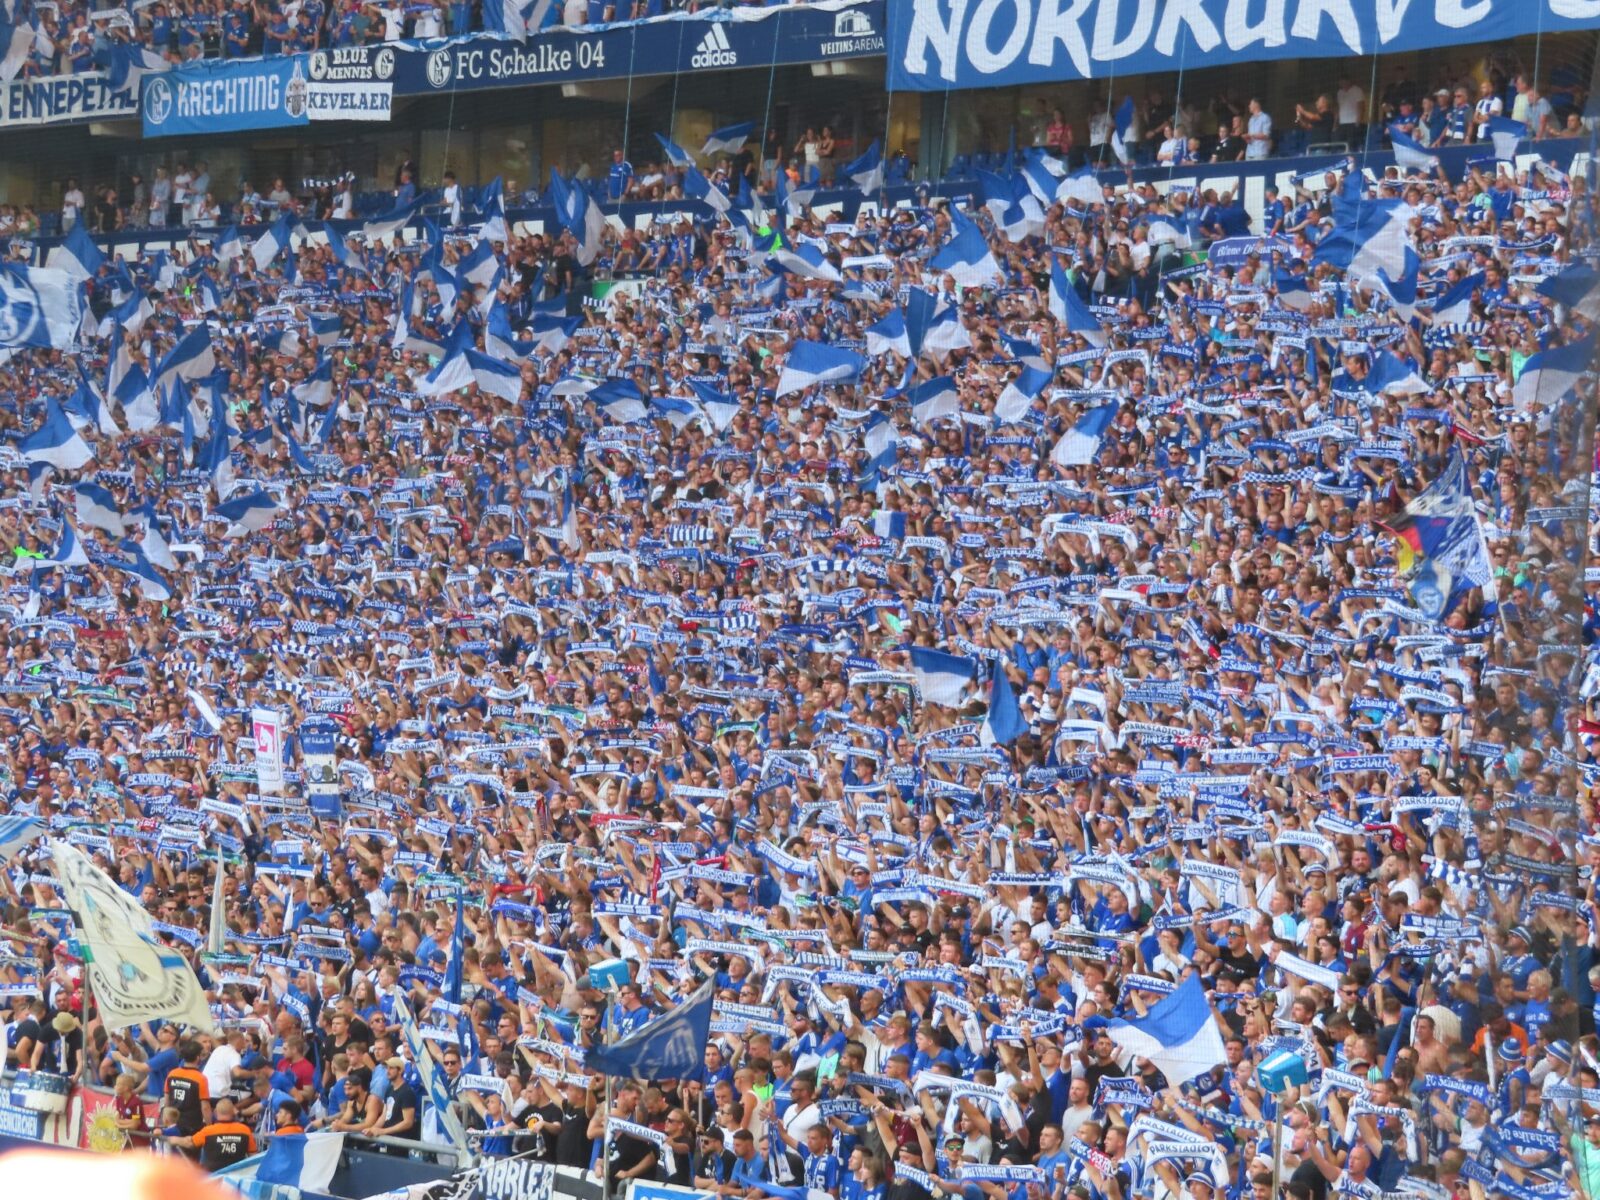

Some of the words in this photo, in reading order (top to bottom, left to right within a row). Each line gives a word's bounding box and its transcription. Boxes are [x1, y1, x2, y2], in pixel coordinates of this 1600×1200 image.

[821, 40, 854, 55] VELTINS
[854, 36, 884, 51] ARENA
[332, 49, 368, 65] BLUE
[456, 50, 483, 79] FC
[489, 44, 571, 78] Schalke
[692, 49, 737, 68] adidas
[326, 65, 372, 80] MENNES
[177, 75, 280, 117] KRECHTING
[308, 91, 390, 110] KEVELAER
[1356, 699, 1387, 709] Schalke
[1124, 722, 1185, 737] PARKSTADION
[1333, 759, 1348, 771] FC
[1350, 755, 1395, 770] SCHALK
[1399, 797, 1463, 810] PARKSTADION
[1182, 863, 1239, 881] PARKSTADION
[902, 968, 954, 981] CHALKE
[1425, 1074, 1437, 1088] FC
[1472, 1085, 1484, 1099] 04
[1513, 1131, 1557, 1151] Schalke
